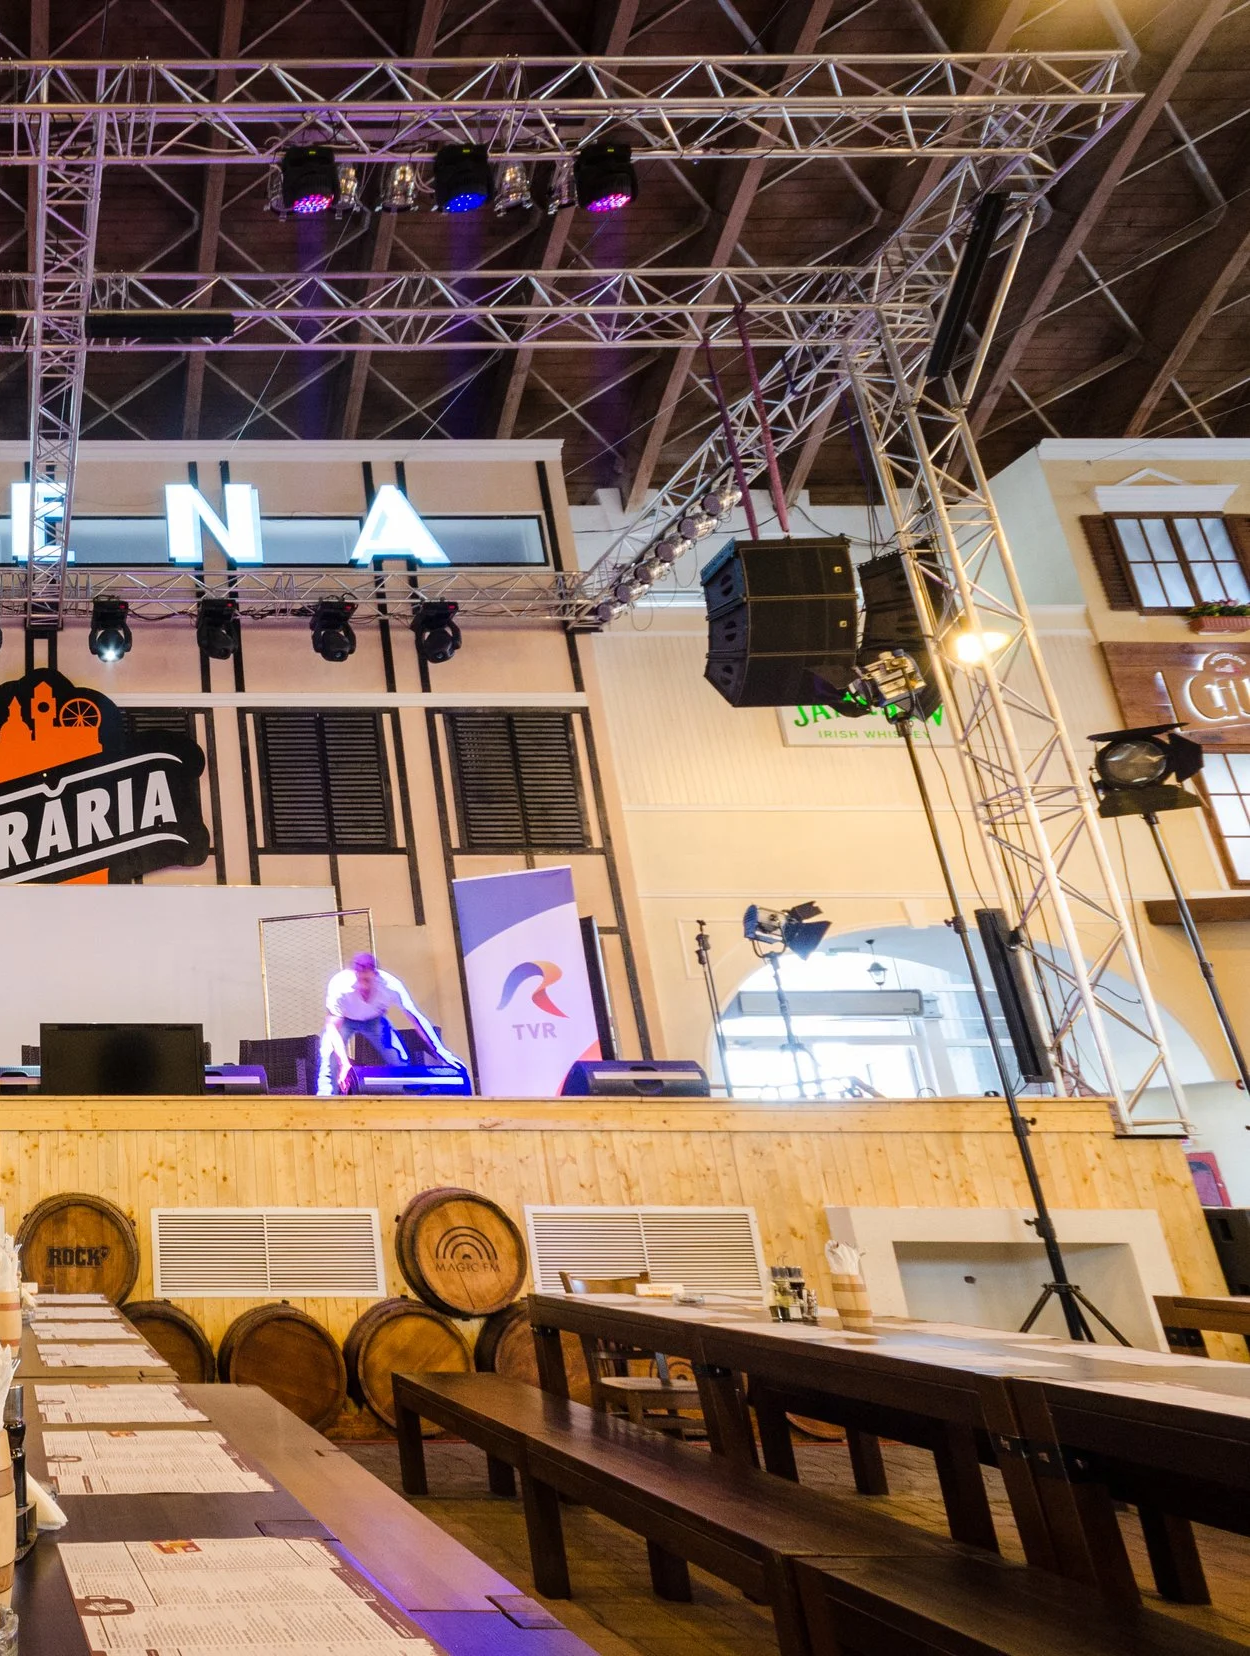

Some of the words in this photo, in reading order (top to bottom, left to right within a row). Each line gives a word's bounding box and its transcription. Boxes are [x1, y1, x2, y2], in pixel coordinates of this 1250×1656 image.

[818, 730, 859, 739] IRISH
[865, 730, 931, 740] WHISEY
[512, 1022, 558, 1041] TVR
[47, 1247, 102, 1267] ROCK
[435, 1263, 479, 1273] MAGIC
[483, 1263, 501, 1273] FM
